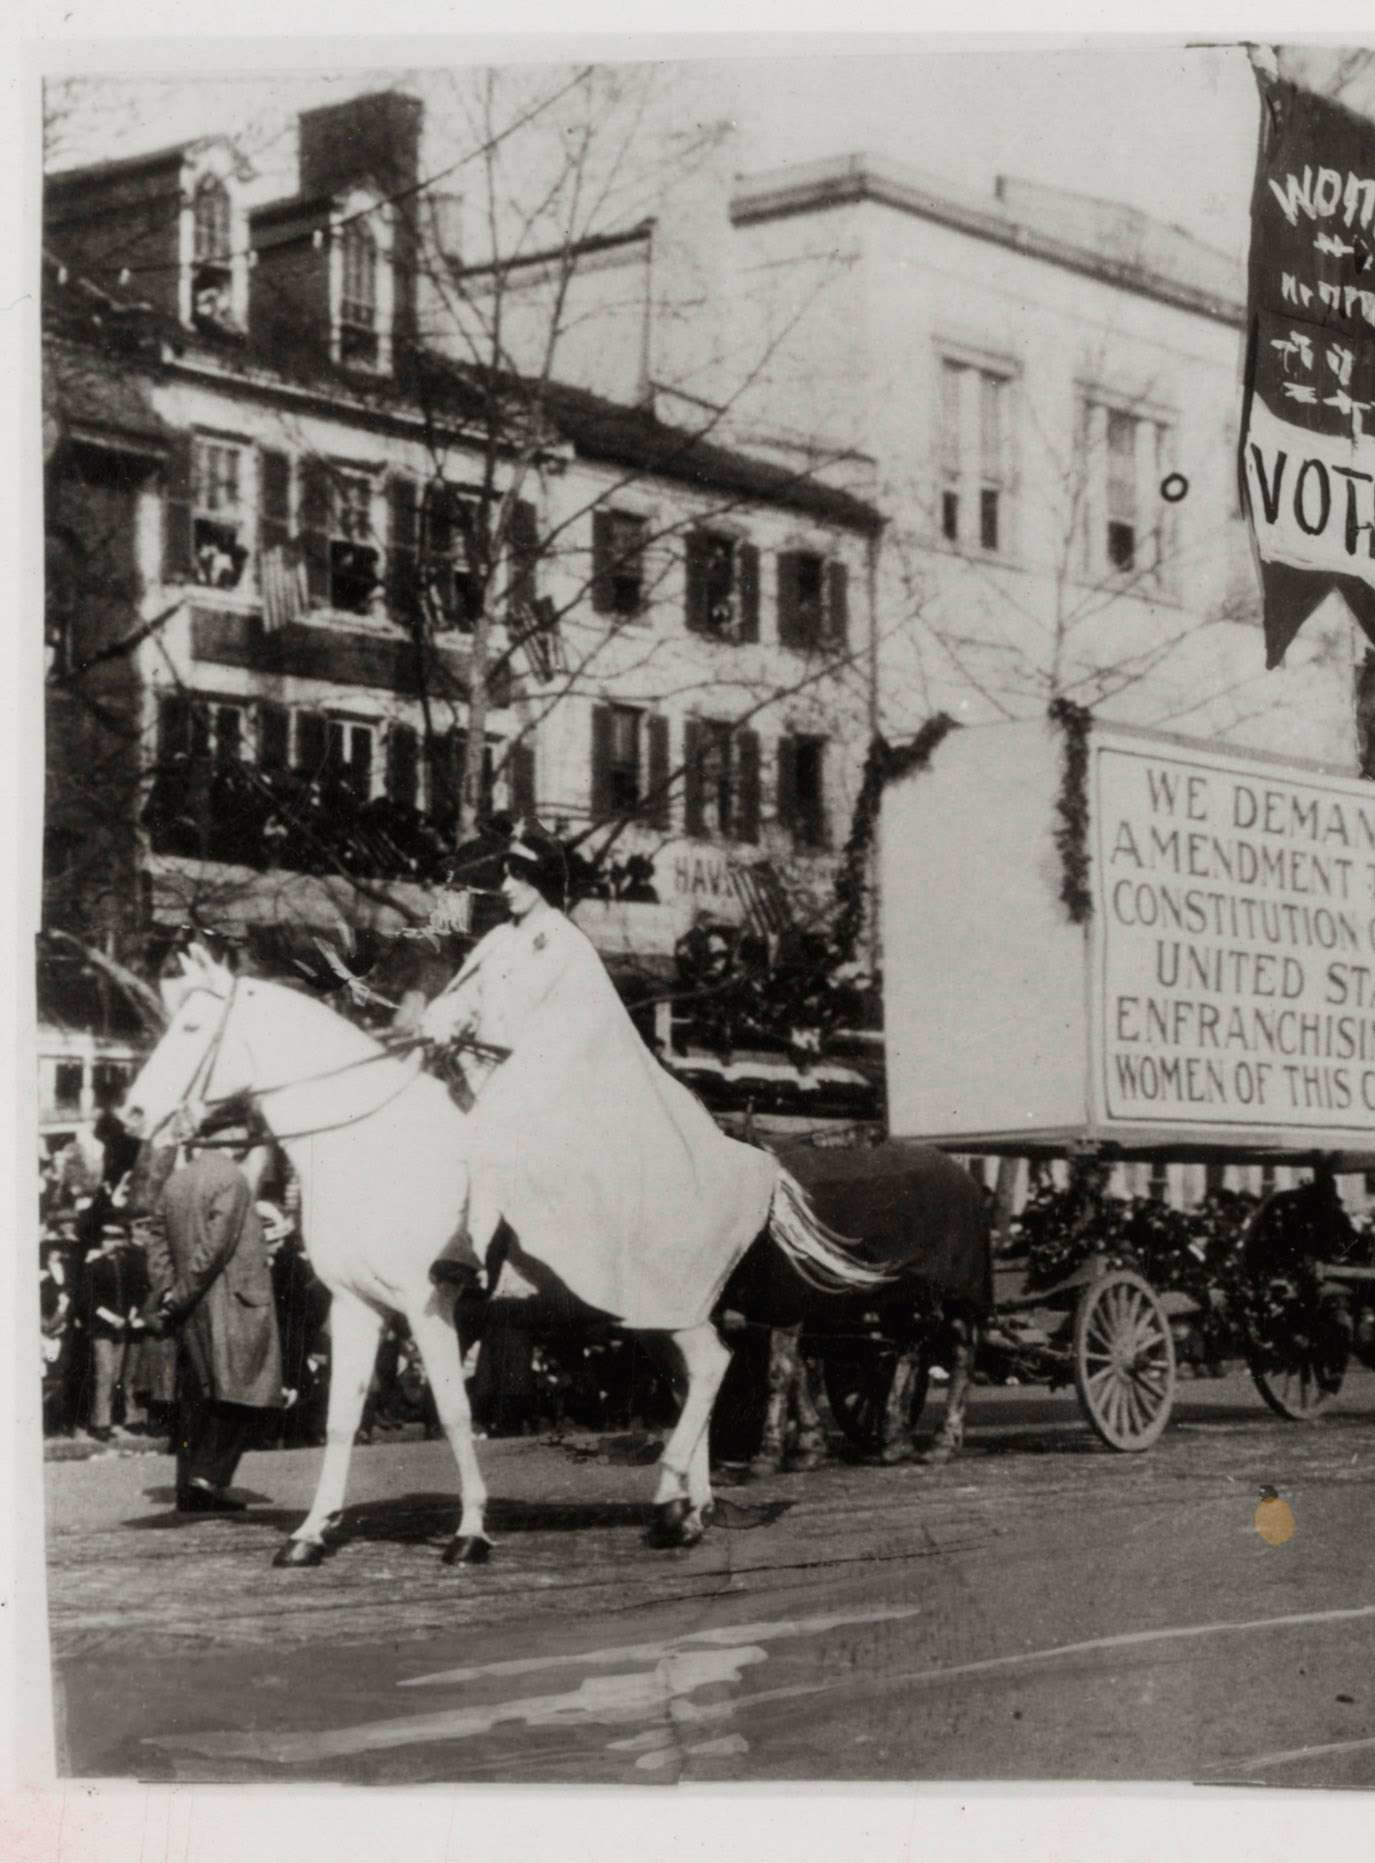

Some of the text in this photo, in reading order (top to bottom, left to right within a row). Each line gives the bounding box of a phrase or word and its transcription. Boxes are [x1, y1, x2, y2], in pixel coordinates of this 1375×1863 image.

[1147, 768, 1208, 821] WE
[1110, 820, 1354, 900] AMENDMENT
[1112, 879, 1361, 951] CONSTITUTION
[1156, 940, 1305, 999] UNITED
[1115, 1053, 1226, 1104] WOMEN
[1235, 1059, 1275, 1105] OF
[1285, 1064, 1353, 1110] THIS
